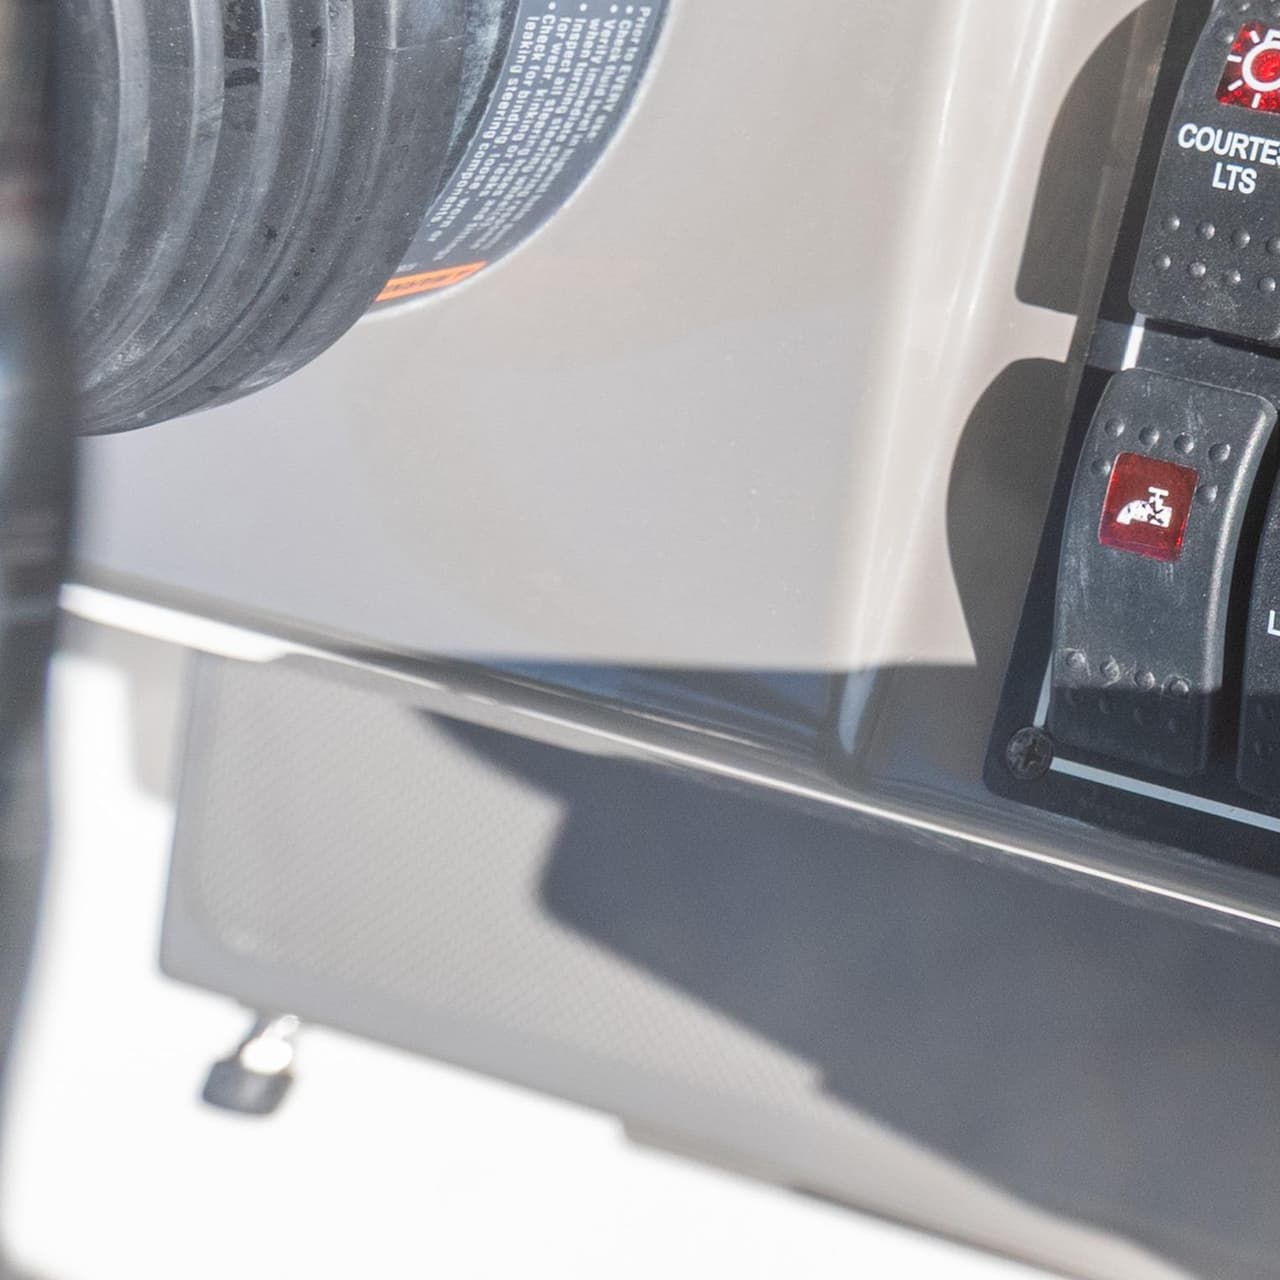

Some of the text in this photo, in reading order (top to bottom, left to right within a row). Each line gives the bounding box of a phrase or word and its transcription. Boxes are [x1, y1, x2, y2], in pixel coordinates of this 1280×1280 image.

[531, 14, 556, 62] Check
[555, 17, 572, 39] for
[558, 18, 587, 73] Inspect
[580, 19, 600, 58] when
[590, 19, 617, 64] Verify
[609, 19, 633, 62] Check
[630, 6, 652, 45] Prior
[522, 65, 541, 87] for
[623, 46, 638, 62] to
[550, 76, 566, 96] all
[554, 62, 588, 114] turning
[594, 65, 617, 97] fluid
[602, 65, 632, 112] EVERY
[426, 16, 541, 228] leaking steering components.
[511, 88, 549, 141] kinking
[517, 98, 556, 156] steering
[556, 67, 600, 143] immediate
[521, 116, 563, 174] steering
[1211, 161, 1257, 195] LTS
